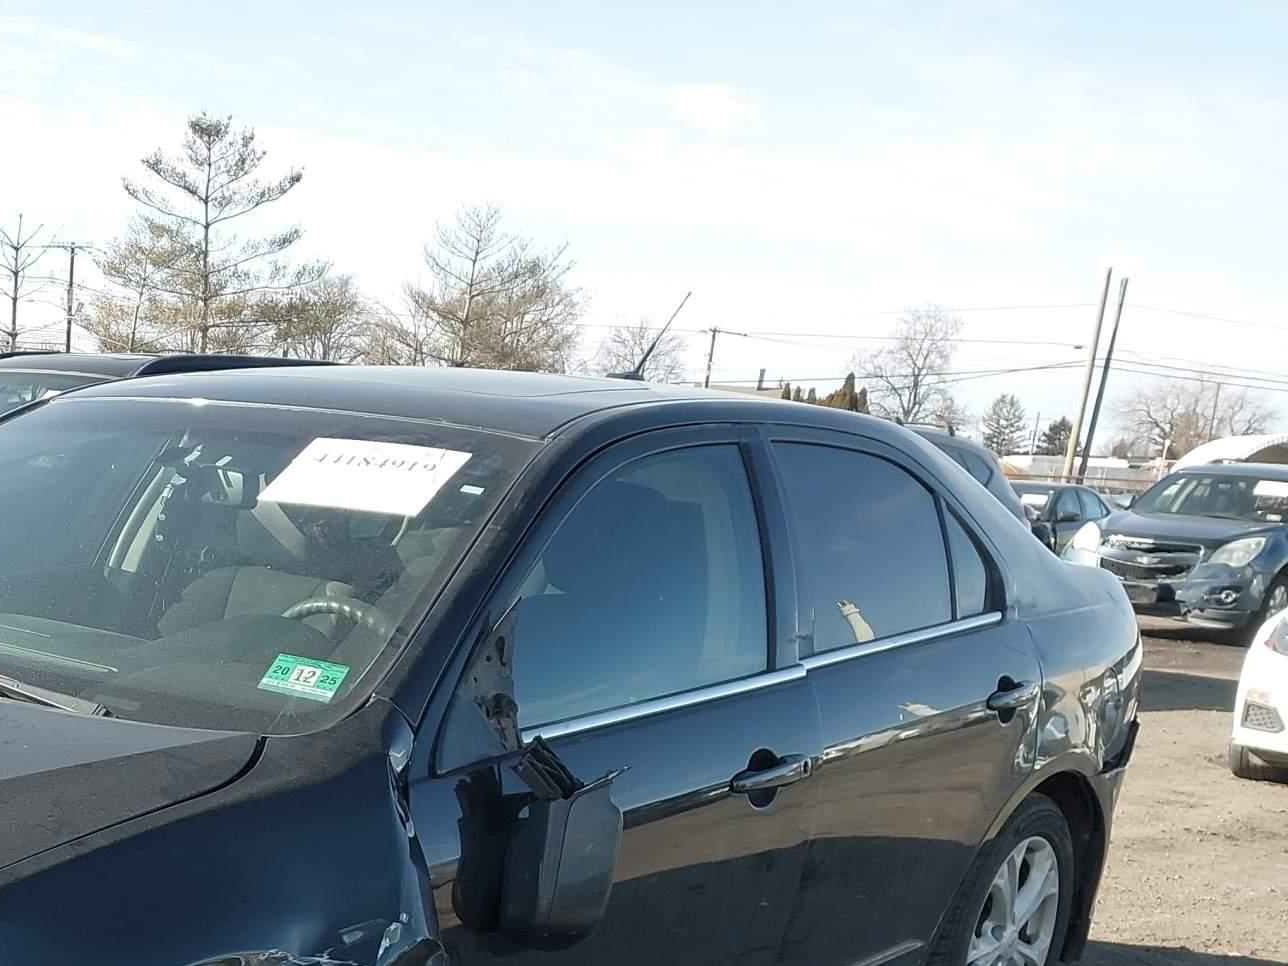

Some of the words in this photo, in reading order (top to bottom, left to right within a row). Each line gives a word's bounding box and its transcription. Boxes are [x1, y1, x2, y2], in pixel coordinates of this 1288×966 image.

[272, 664, 291, 676] 20
[293, 668, 317, 684] 12
[319, 675, 339, 686] 25
